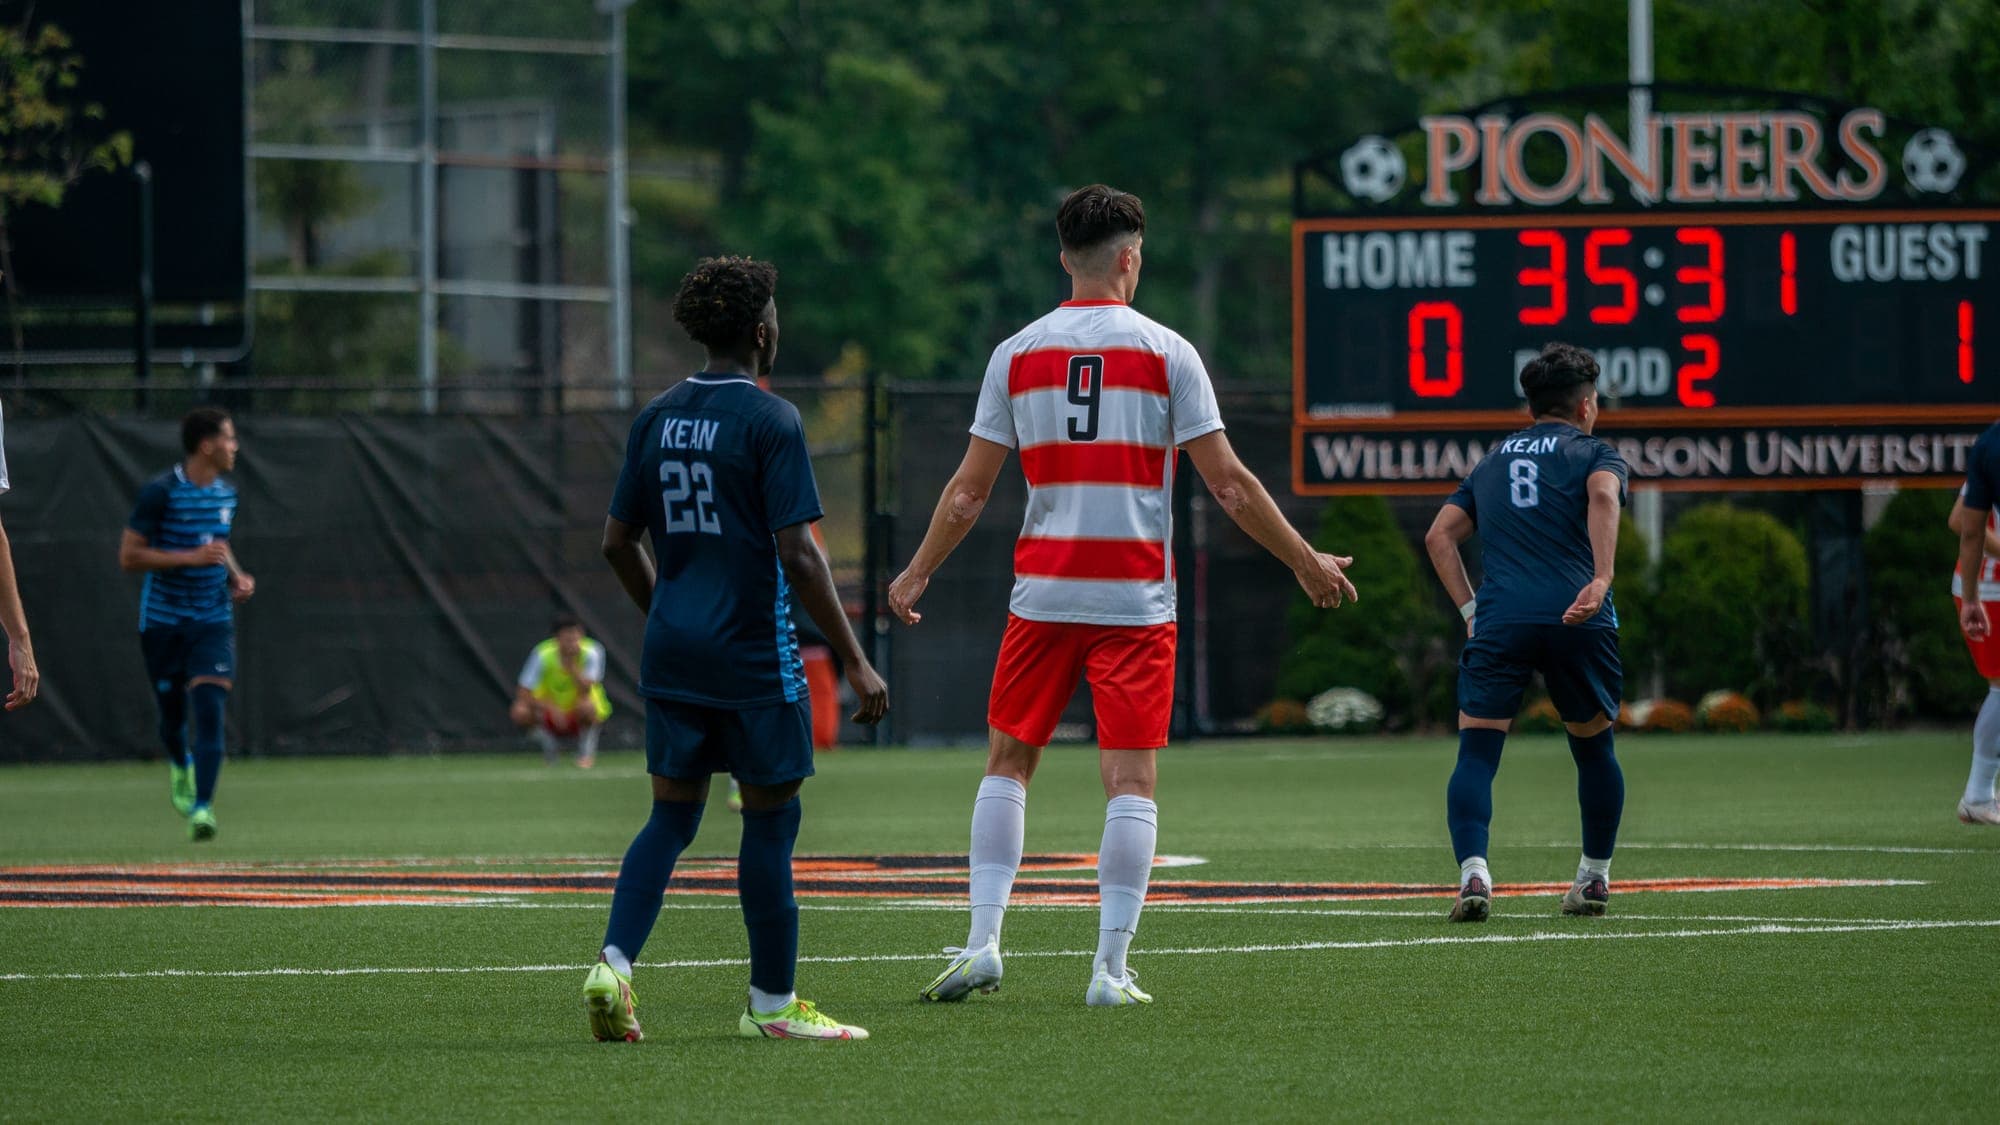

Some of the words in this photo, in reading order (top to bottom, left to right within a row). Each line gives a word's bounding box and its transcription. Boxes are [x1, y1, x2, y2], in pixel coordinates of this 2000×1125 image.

[1419, 110, 1887, 207] PIONEERS
[1322, 231, 1476, 290] HOME
[1829, 223, 1989, 283] GUEST
[1408, 301, 1463, 398] 0
[1513, 347, 1673, 397] IOD
[1676, 333, 1721, 408] 2
[1957, 299, 1975, 385] 1
[1066, 355, 1104, 443] 9
[661, 418, 720, 451] KEAN
[1500, 436, 1558, 456] KEAN
[1602, 435, 1733, 477] RSON
[1745, 430, 1979, 476] UNIVERSIT
[659, 461, 722, 535] 22
[1509, 458, 1539, 508] 8
